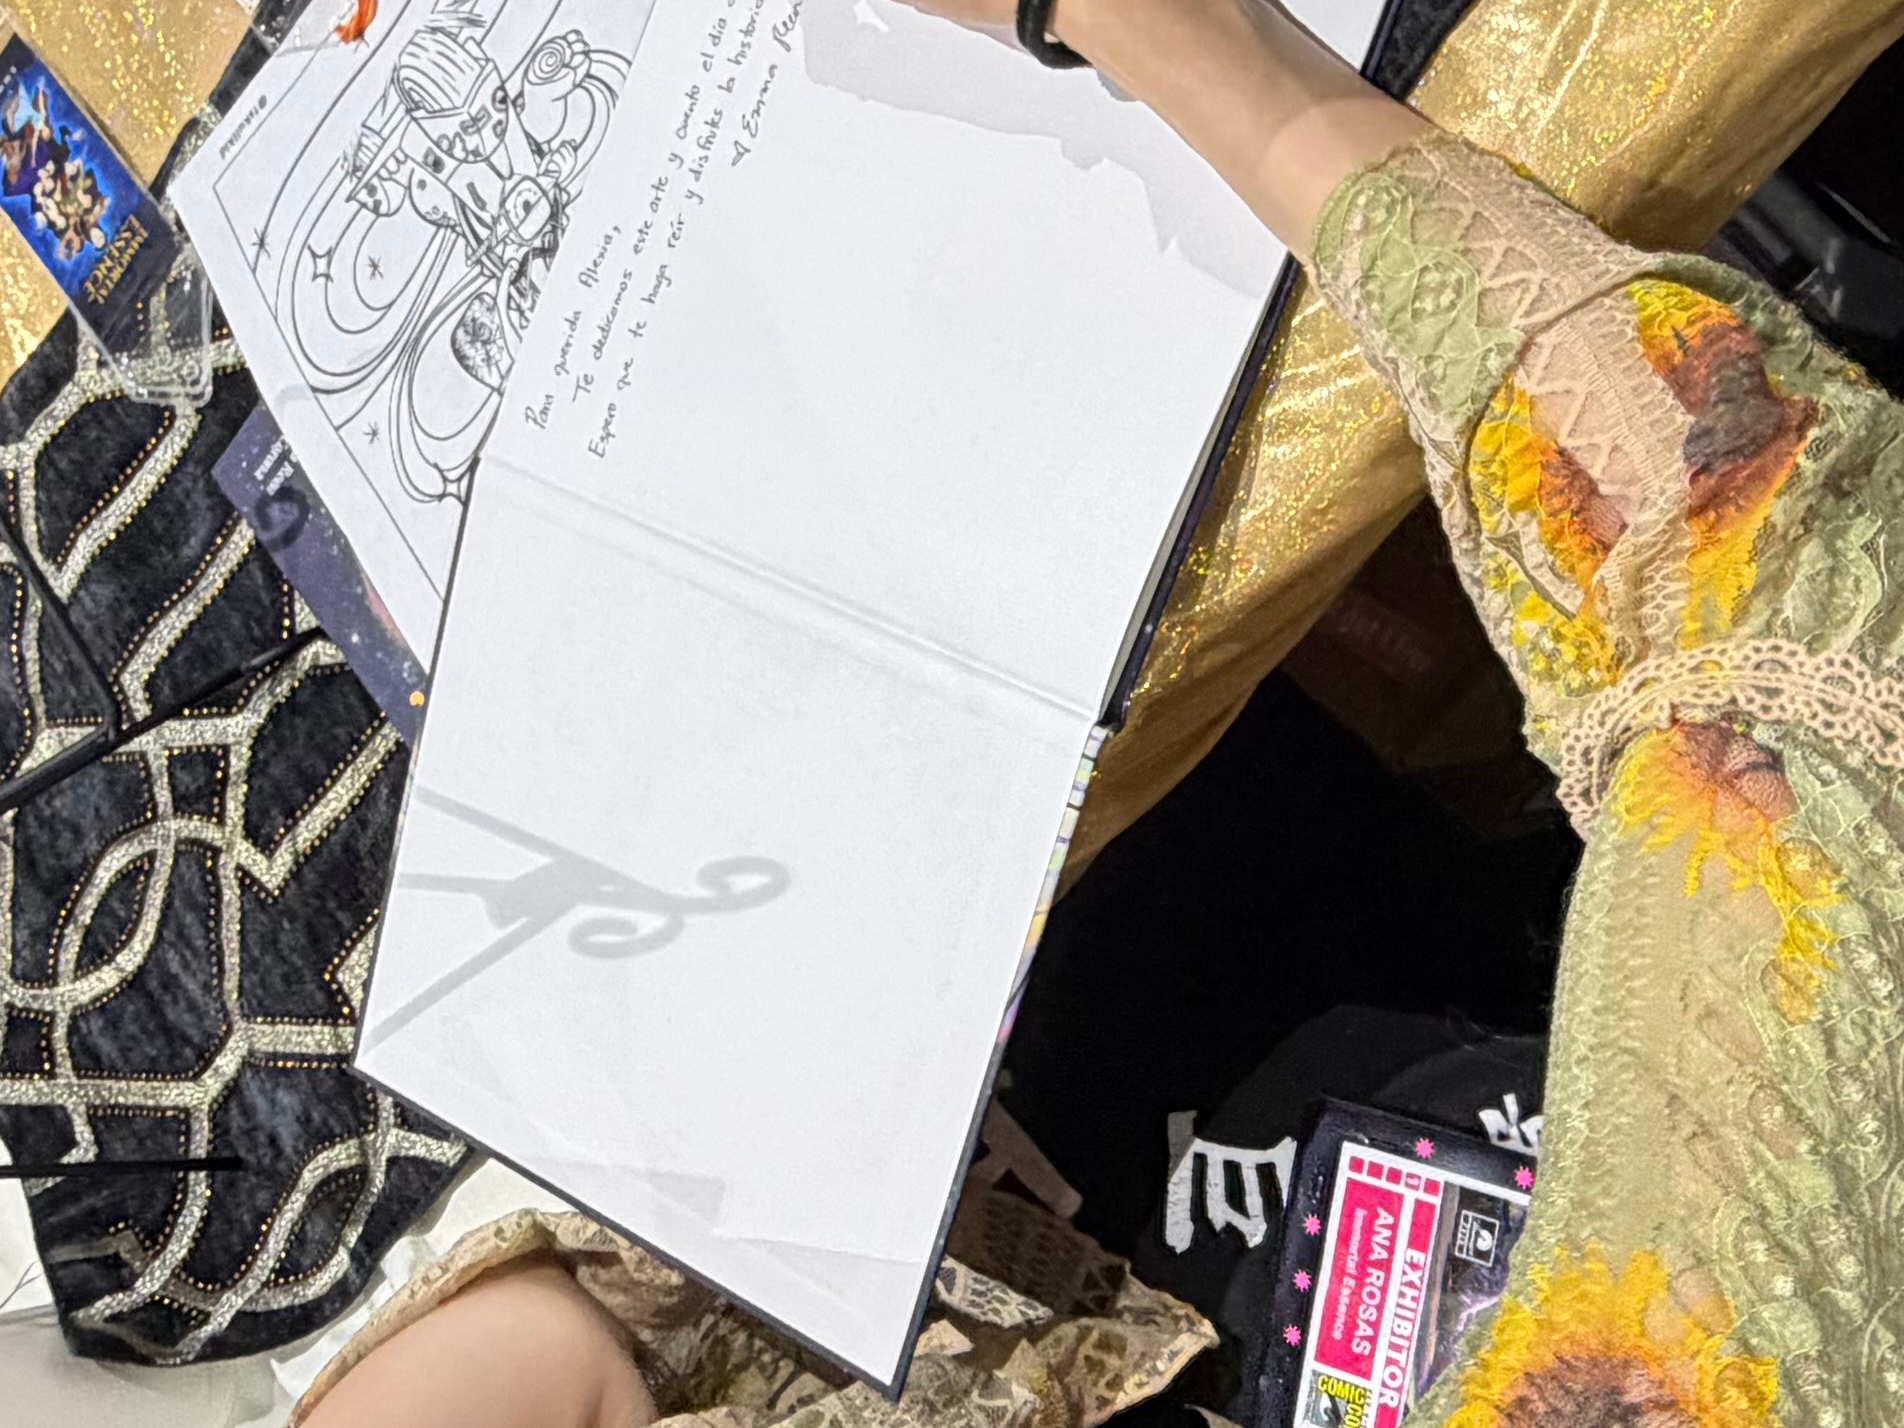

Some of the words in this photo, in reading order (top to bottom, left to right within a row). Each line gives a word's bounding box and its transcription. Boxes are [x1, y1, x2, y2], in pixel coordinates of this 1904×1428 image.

[700, 52, 718, 74] el
[674, 84, 702, 139] cuento
[739, 61, 779, 138] Emma
[668, 150, 685, 168] y
[646, 174, 671, 213] arte
[82, 214, 139, 303] ESSENCE
[629, 216, 655, 257] este
[586, 402, 620, 459] Espero
[615, 356, 637, 392] que
[629, 316, 648, 339] te
[640, 260, 673, 307] haga
[686, 188, 703, 206] y
[591, 267, 635, 360] dedicamos
[519, 389, 558, 429] Para
[551, 308, 585, 377] querida
[569, 370, 597, 401] Te
[1343, 1207, 1368, 1275] Immortal
[1369, 1206, 1395, 1262] ANA
[1330, 1276, 1356, 1341] Essence
[1350, 1265, 1384, 1357] ROSAS
[1377, 1246, 1428, 1409] EXHIBITOR
[1316, 1372, 1367, 1405] COMIC
